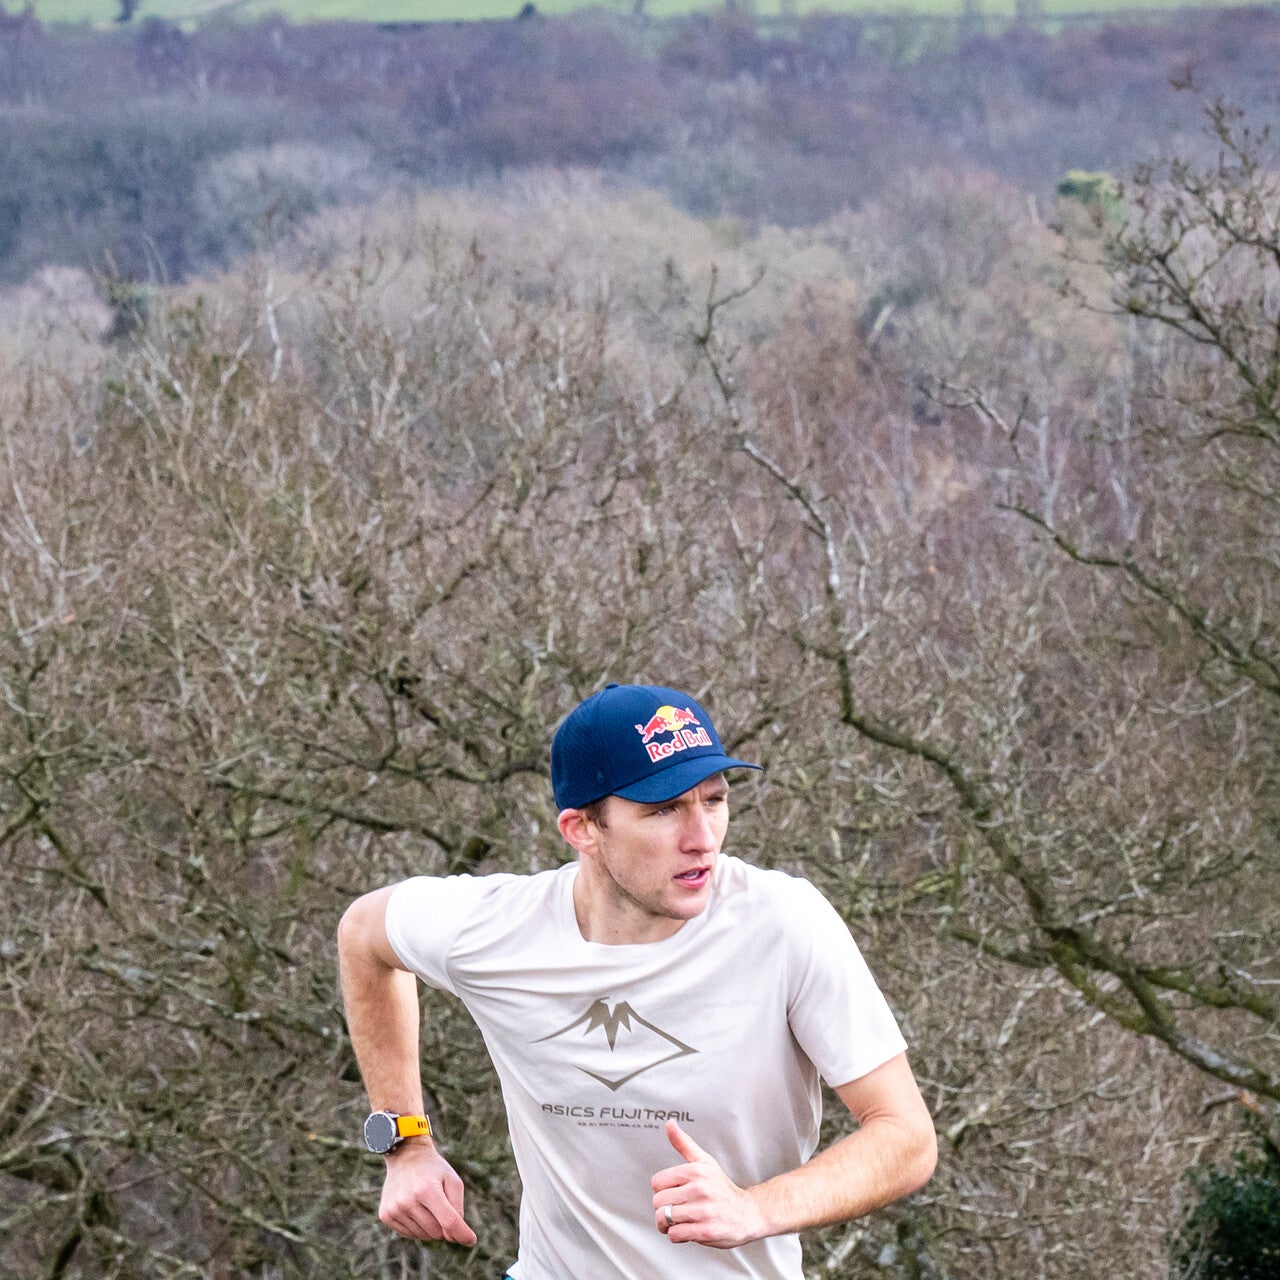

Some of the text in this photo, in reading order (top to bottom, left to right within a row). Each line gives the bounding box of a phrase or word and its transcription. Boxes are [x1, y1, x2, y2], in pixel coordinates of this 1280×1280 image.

[647, 728, 711, 760] Red Bull
[541, 1103, 695, 1122] ASICS FUJITRAIL
